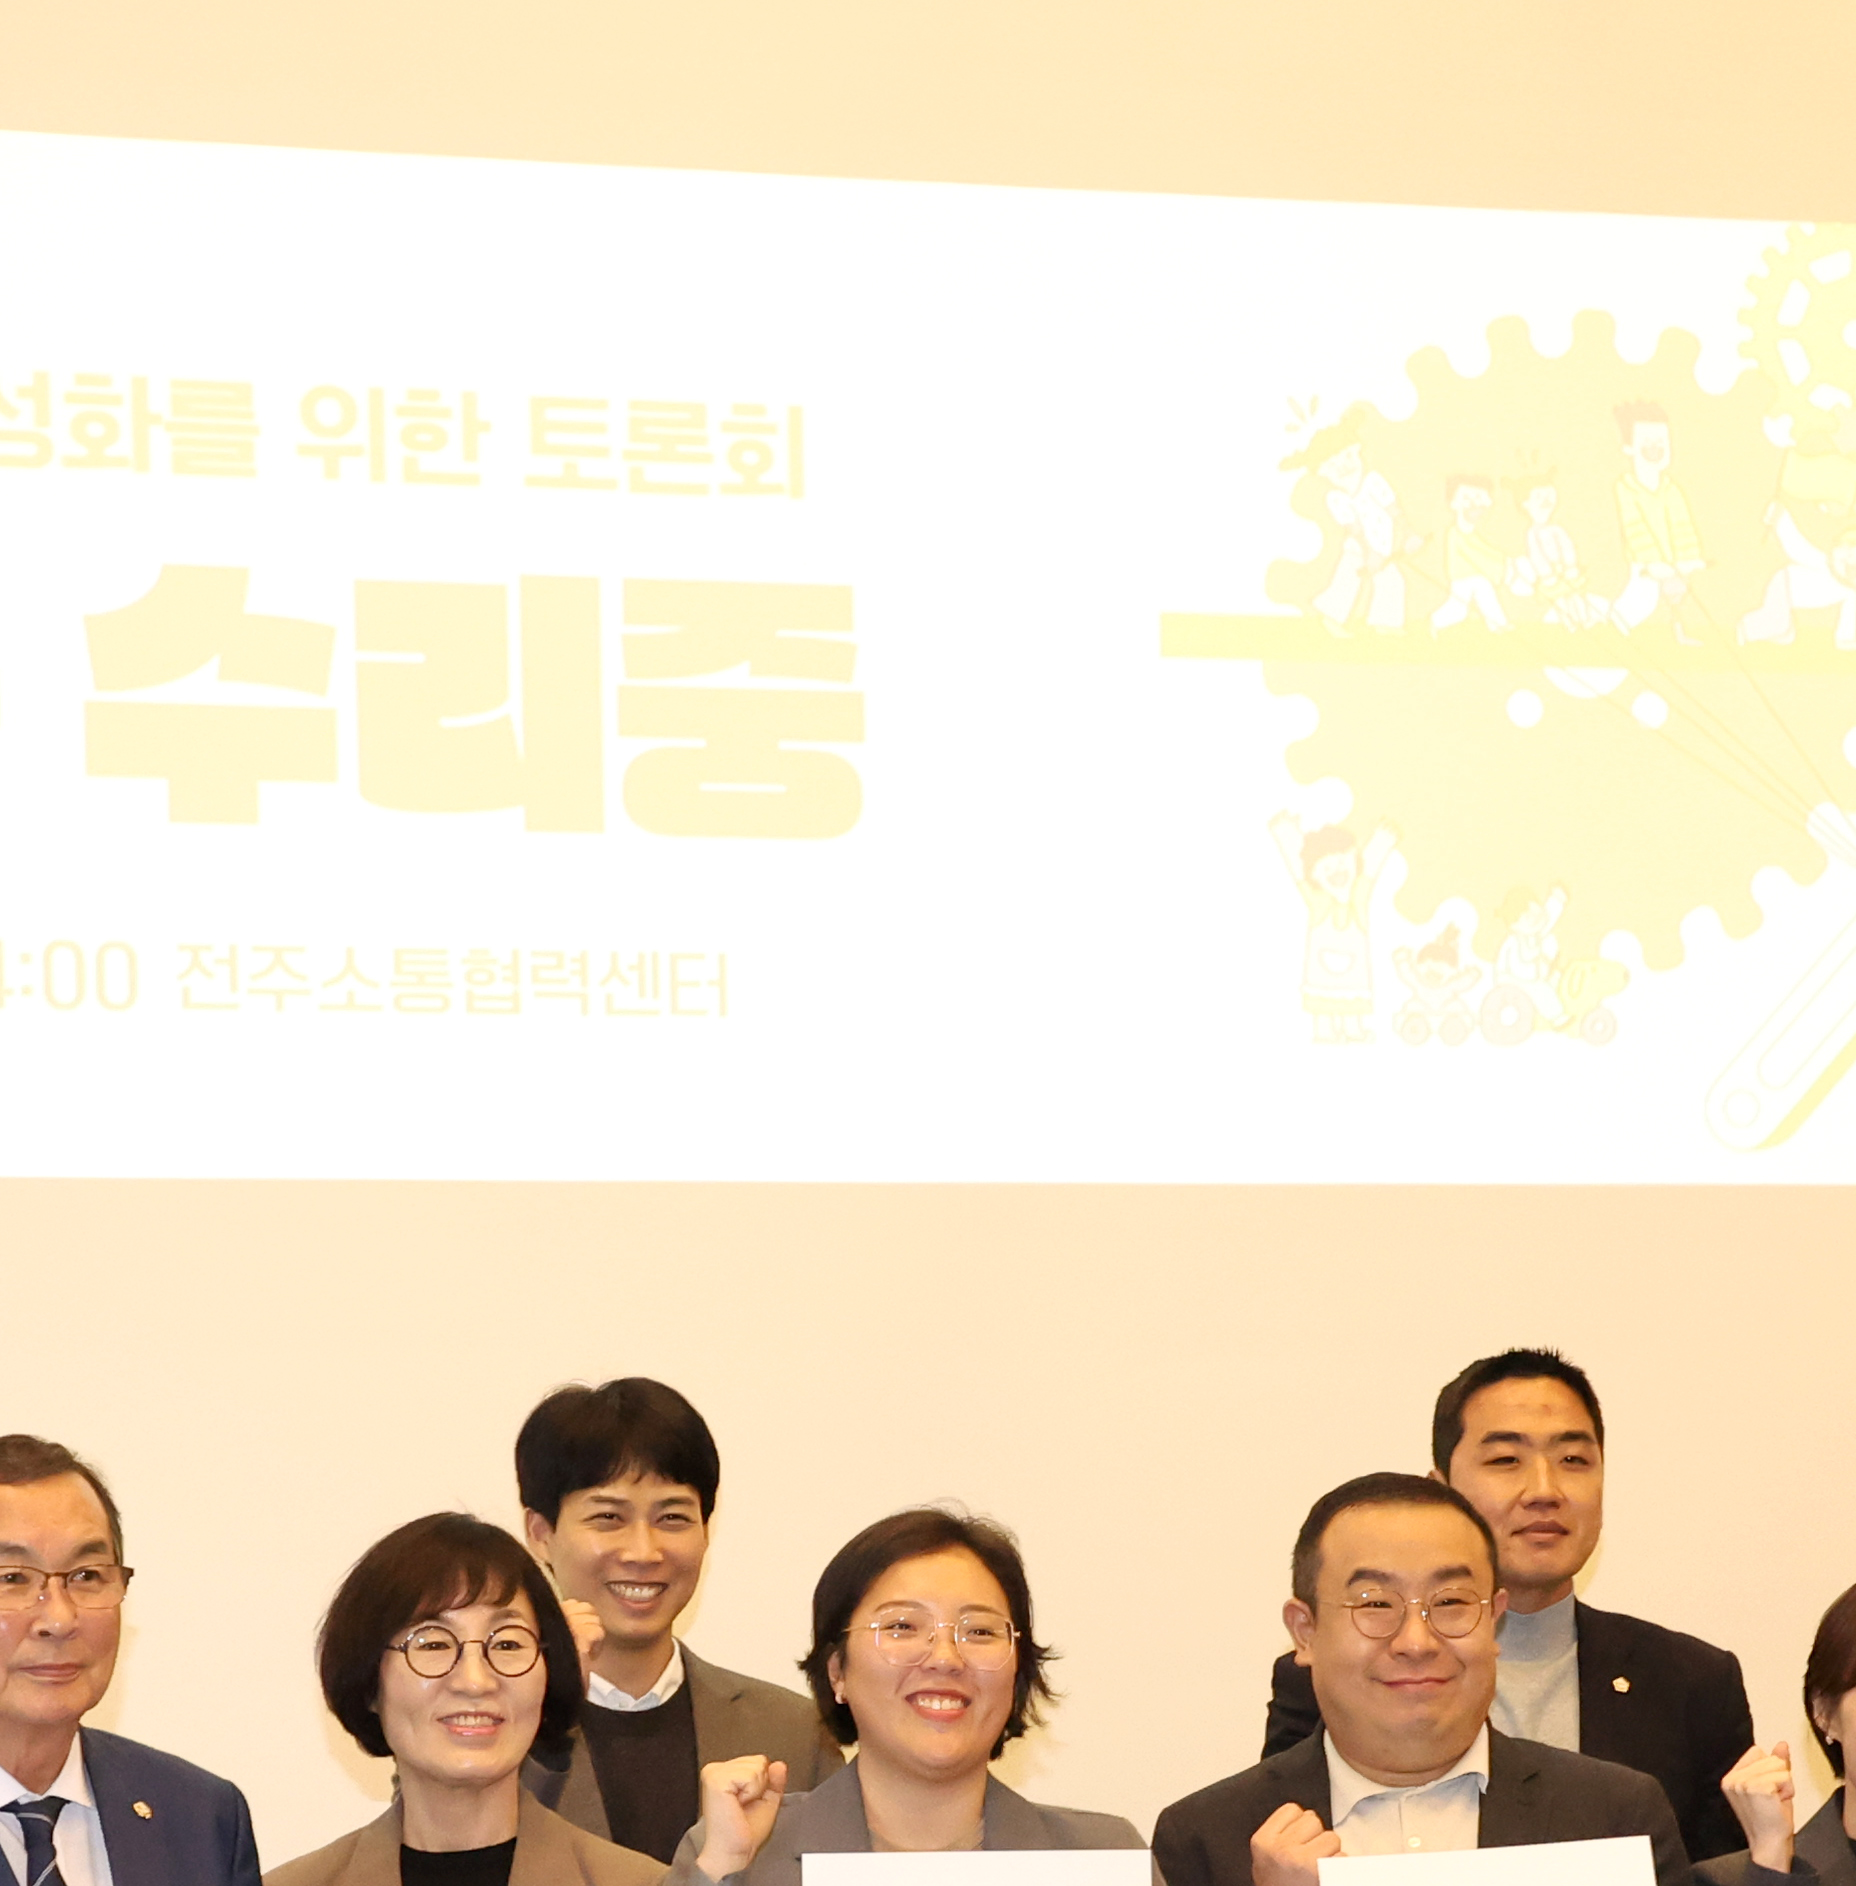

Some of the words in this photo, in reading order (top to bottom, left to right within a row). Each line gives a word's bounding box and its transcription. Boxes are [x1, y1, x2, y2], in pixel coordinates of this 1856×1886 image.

[296, 385, 492, 487] 위한
[524, 396, 806, 500] 토론회
[83, 564, 867, 840] 수리중
[178, 944, 728, 1018] 전주소통협력센터
